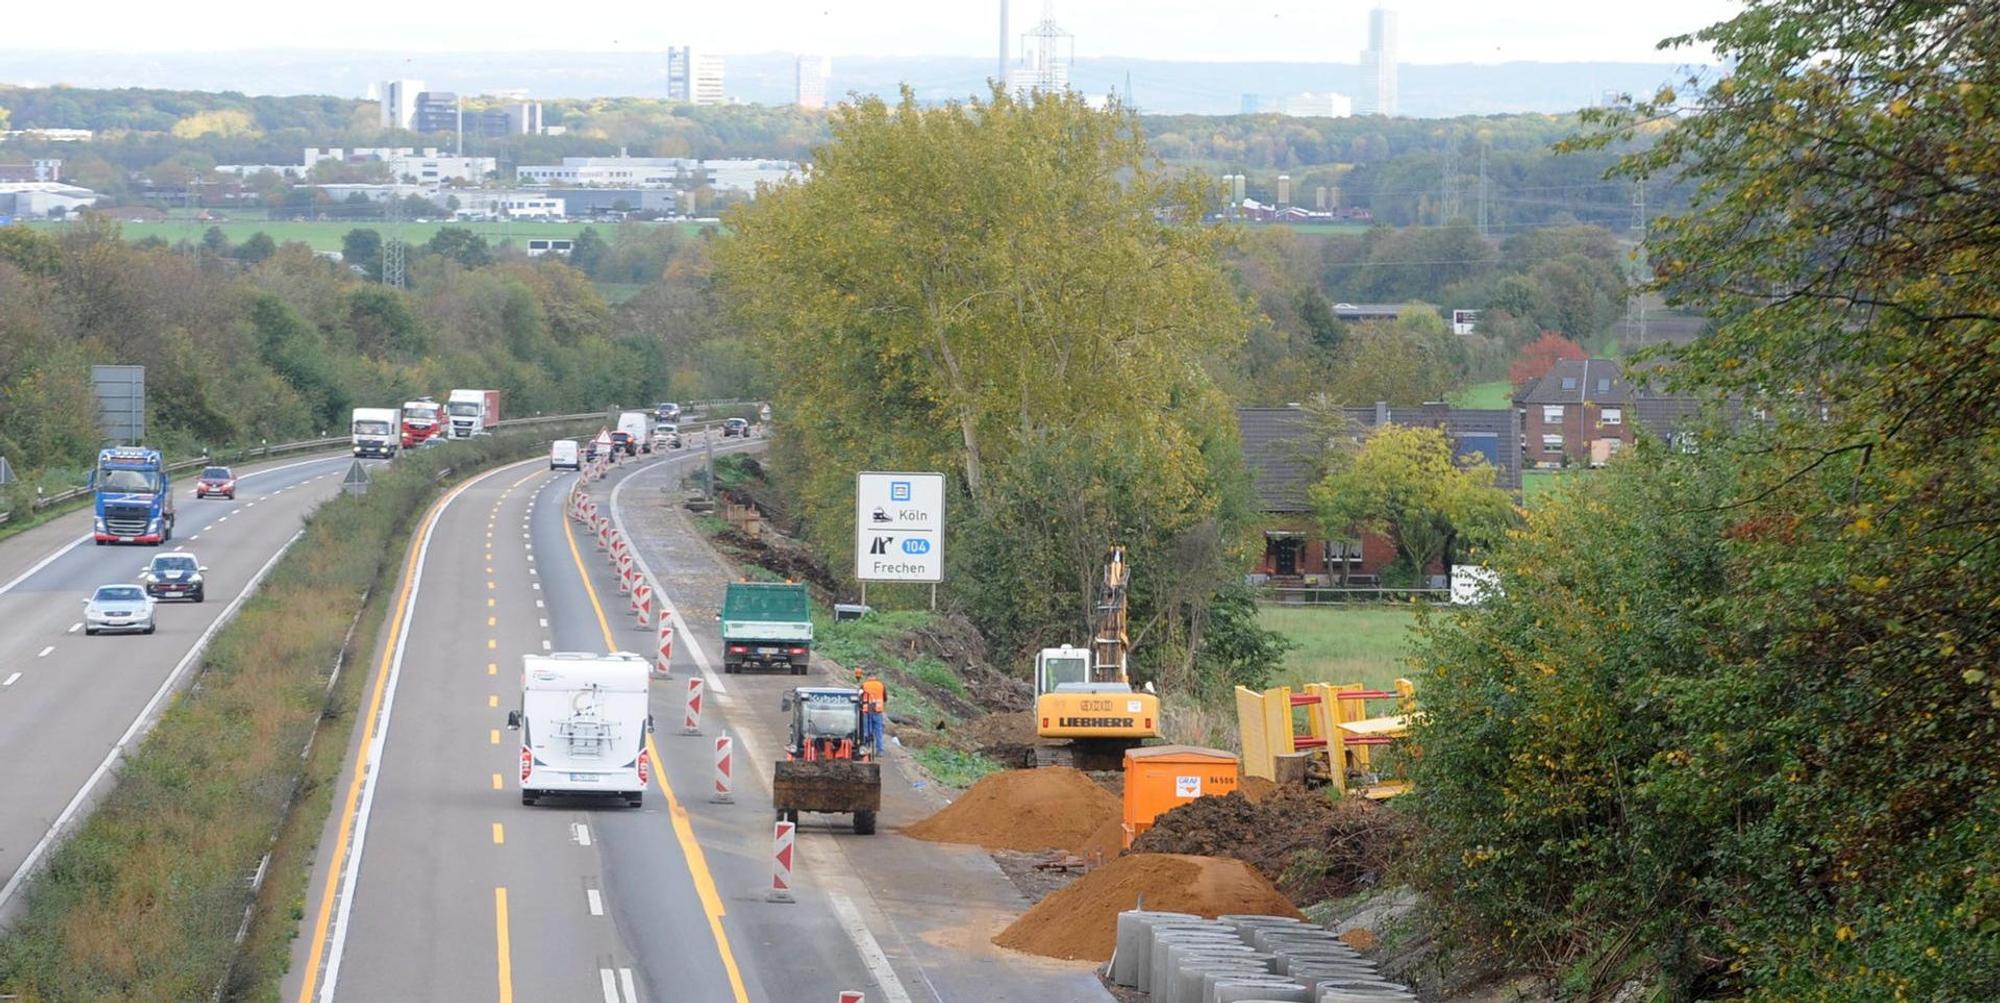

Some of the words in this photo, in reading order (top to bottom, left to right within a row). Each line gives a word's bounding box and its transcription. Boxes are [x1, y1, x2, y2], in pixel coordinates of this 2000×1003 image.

[899, 510, 928, 521] Köln
[906, 541, 926, 552] 104
[873, 561, 926, 574] Frechen
[809, 694, 849, 704] Kubota
[1059, 717, 1134, 728] LIEBHERR
